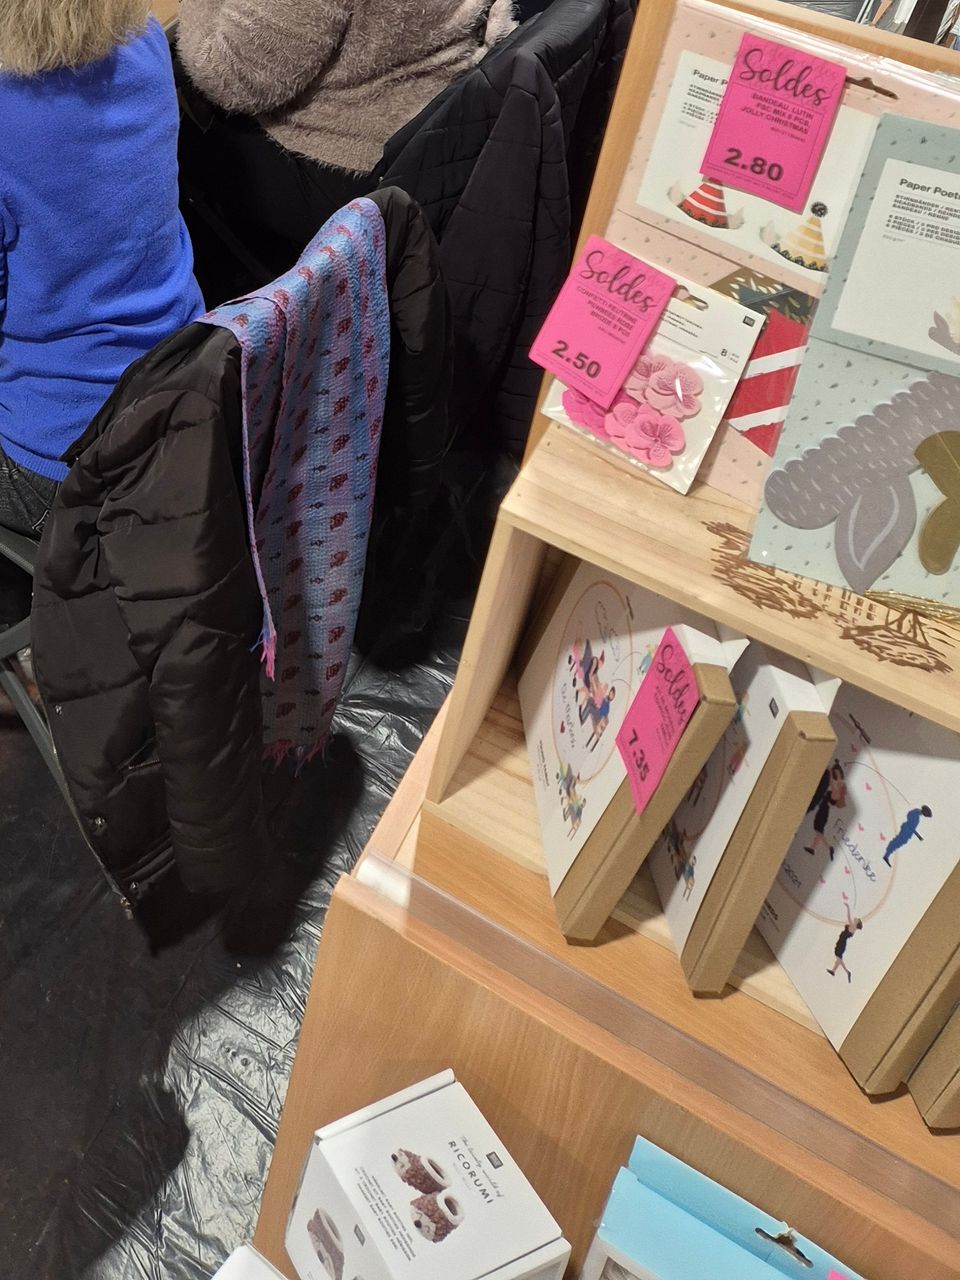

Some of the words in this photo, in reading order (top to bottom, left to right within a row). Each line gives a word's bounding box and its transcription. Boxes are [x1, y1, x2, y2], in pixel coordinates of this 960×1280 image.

[693, 69, 720, 84] Paper
[740, 49, 831, 107] Soldes
[766, 113, 808, 135] CHRISTMAS
[792, 107, 814, 120] LUTIN
[724, 147, 783, 181] 2.80
[899, 178, 931, 193] Paper
[579, 250, 657, 313] Soldes
[552, 340, 602, 378] 2.50
[628, 728, 650, 782] 7.35
[448, 1140, 494, 1204] RICORUMI
